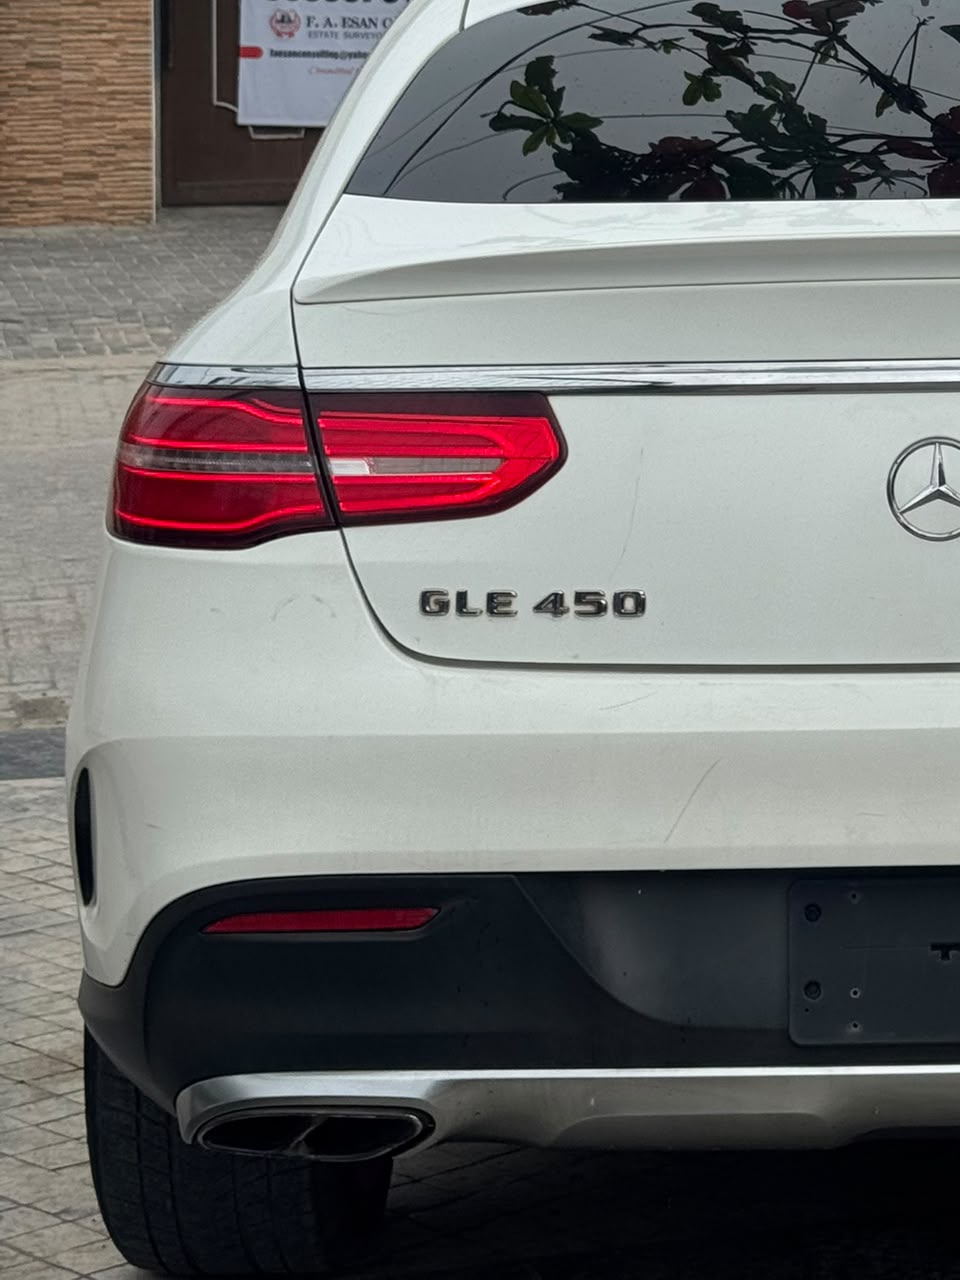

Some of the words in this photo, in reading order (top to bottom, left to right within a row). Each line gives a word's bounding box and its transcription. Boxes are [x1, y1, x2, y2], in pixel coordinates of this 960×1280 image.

[342, 17, 378, 29] ESAN
[308, 31, 338, 40] ESTATE
[419, 588, 518, 617] GLE
[532, 589, 647, 617] 450
